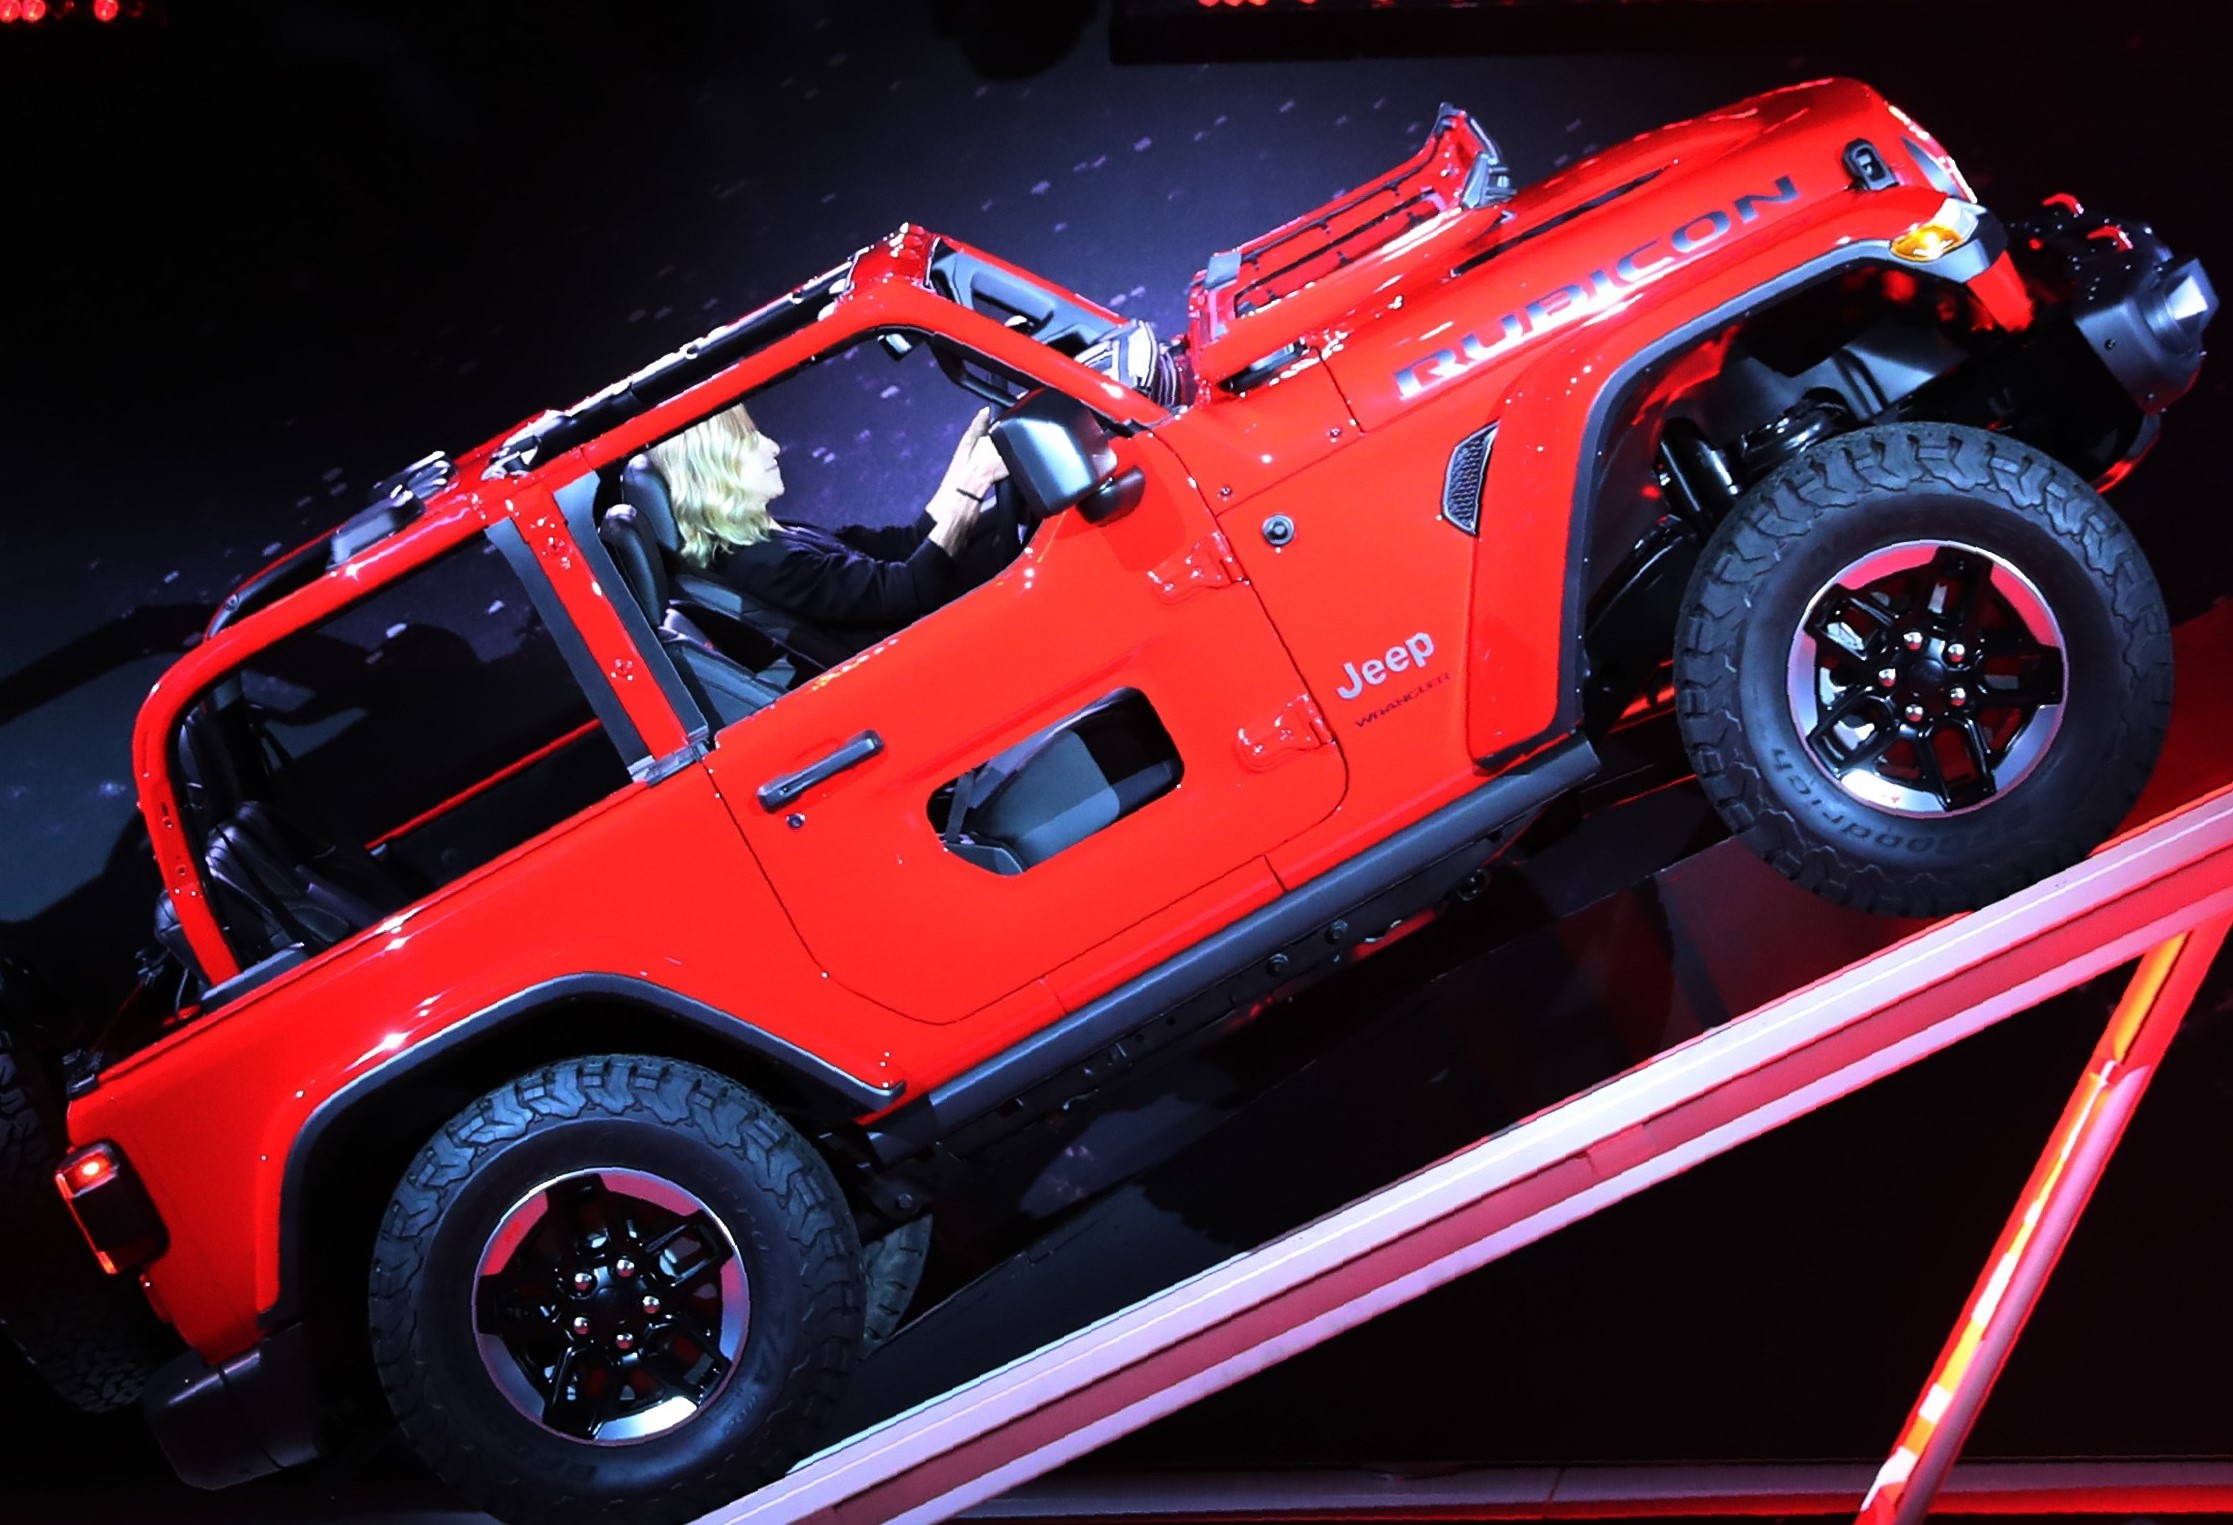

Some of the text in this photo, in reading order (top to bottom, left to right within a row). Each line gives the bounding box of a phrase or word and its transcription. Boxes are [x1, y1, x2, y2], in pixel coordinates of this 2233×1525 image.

[1394, 175, 1799, 400] RUBICON
[1336, 631, 1435, 700] Jeep
[1355, 672, 1450, 728] WRANGLER
